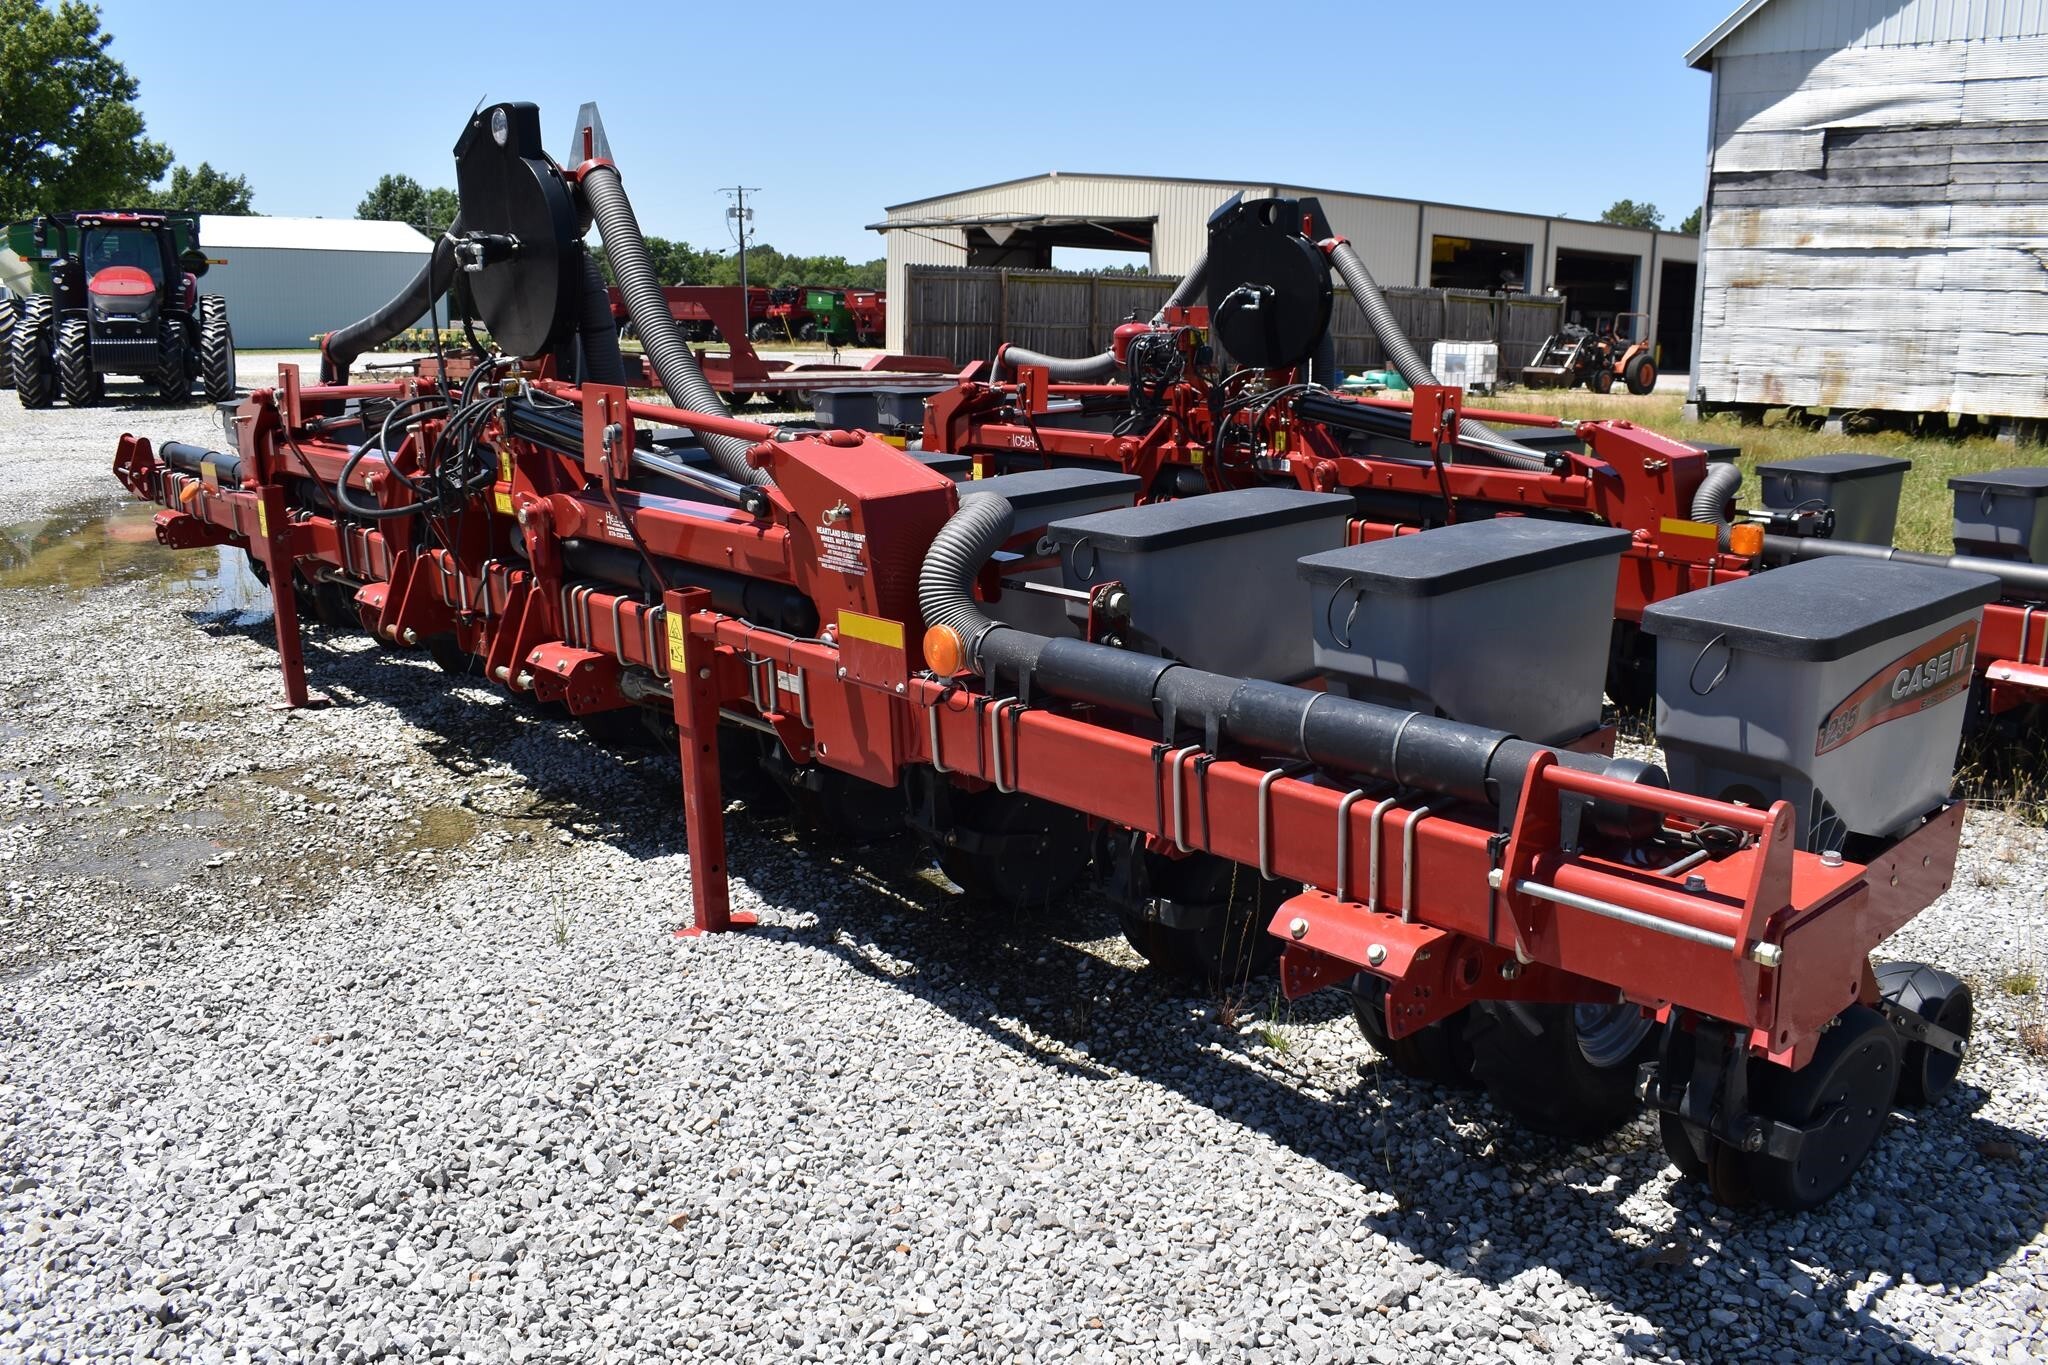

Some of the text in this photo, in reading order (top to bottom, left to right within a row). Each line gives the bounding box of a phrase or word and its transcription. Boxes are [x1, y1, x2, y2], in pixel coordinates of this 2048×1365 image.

[816, 526, 841, 537] HEARTLAND
[1891, 650, 1952, 700] CASE
[1819, 703, 1860, 747] 1235
